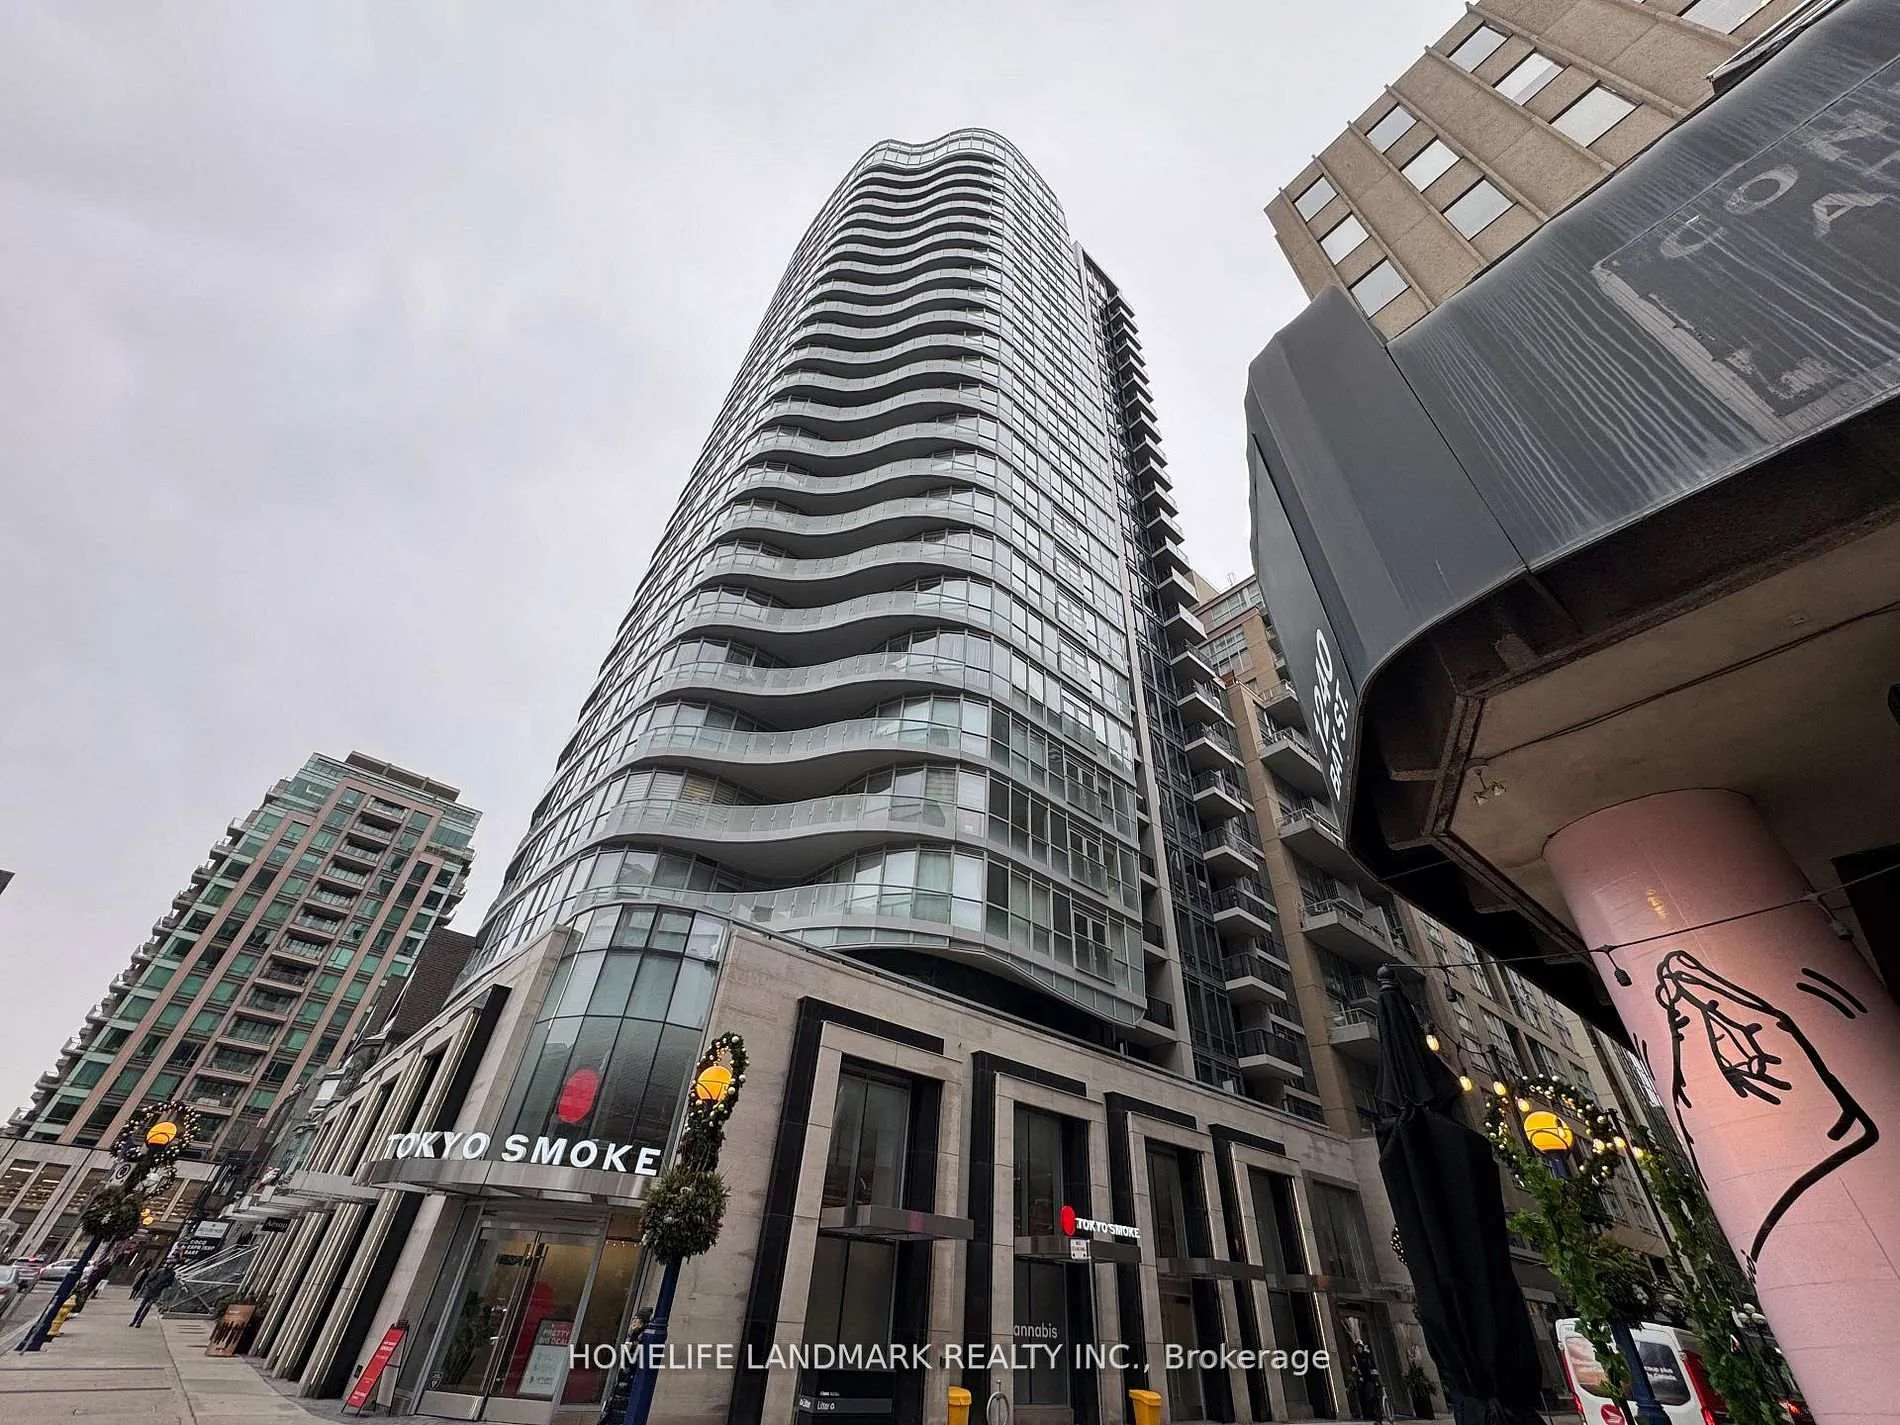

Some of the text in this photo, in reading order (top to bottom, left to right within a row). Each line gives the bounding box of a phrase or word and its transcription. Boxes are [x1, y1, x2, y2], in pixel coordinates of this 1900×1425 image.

[1313, 629, 1333, 756] 1240
[1329, 678, 1349, 801] BAY ST.
[386, 1131, 662, 1177] TOKYO SMOKE
[1075, 1217, 1141, 1239] TOKYO SMOKE
[1014, 1323, 1058, 1338] annabis
